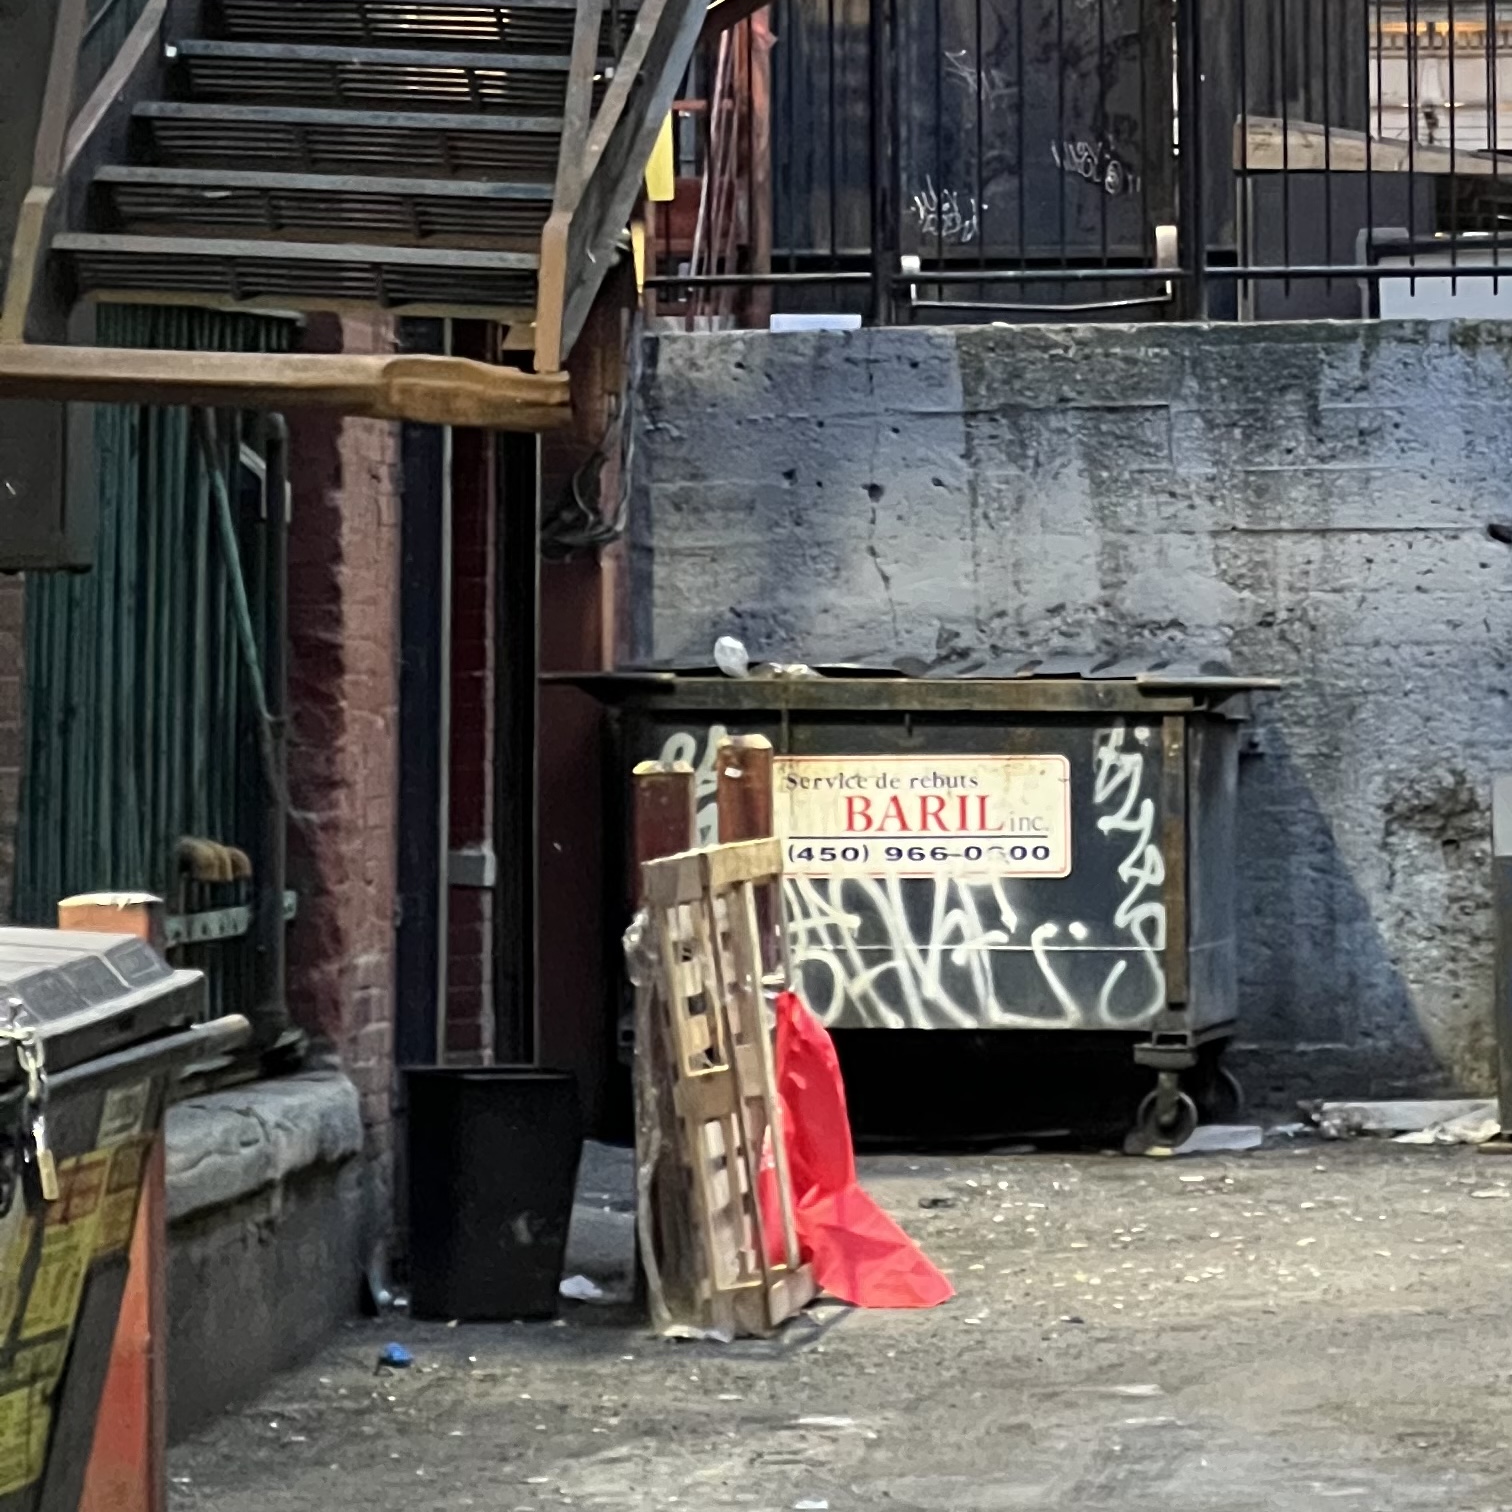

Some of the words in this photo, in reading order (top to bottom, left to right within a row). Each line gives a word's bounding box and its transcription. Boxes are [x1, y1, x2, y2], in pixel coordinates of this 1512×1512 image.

[786, 772, 868, 790] Service
[875, 772, 900, 790] de
[910, 771, 979, 789] rebuts
[844, 794, 1004, 833] BARIL
[1009, 810, 1050, 832] inc.
[788, 844, 869, 863] (450)
